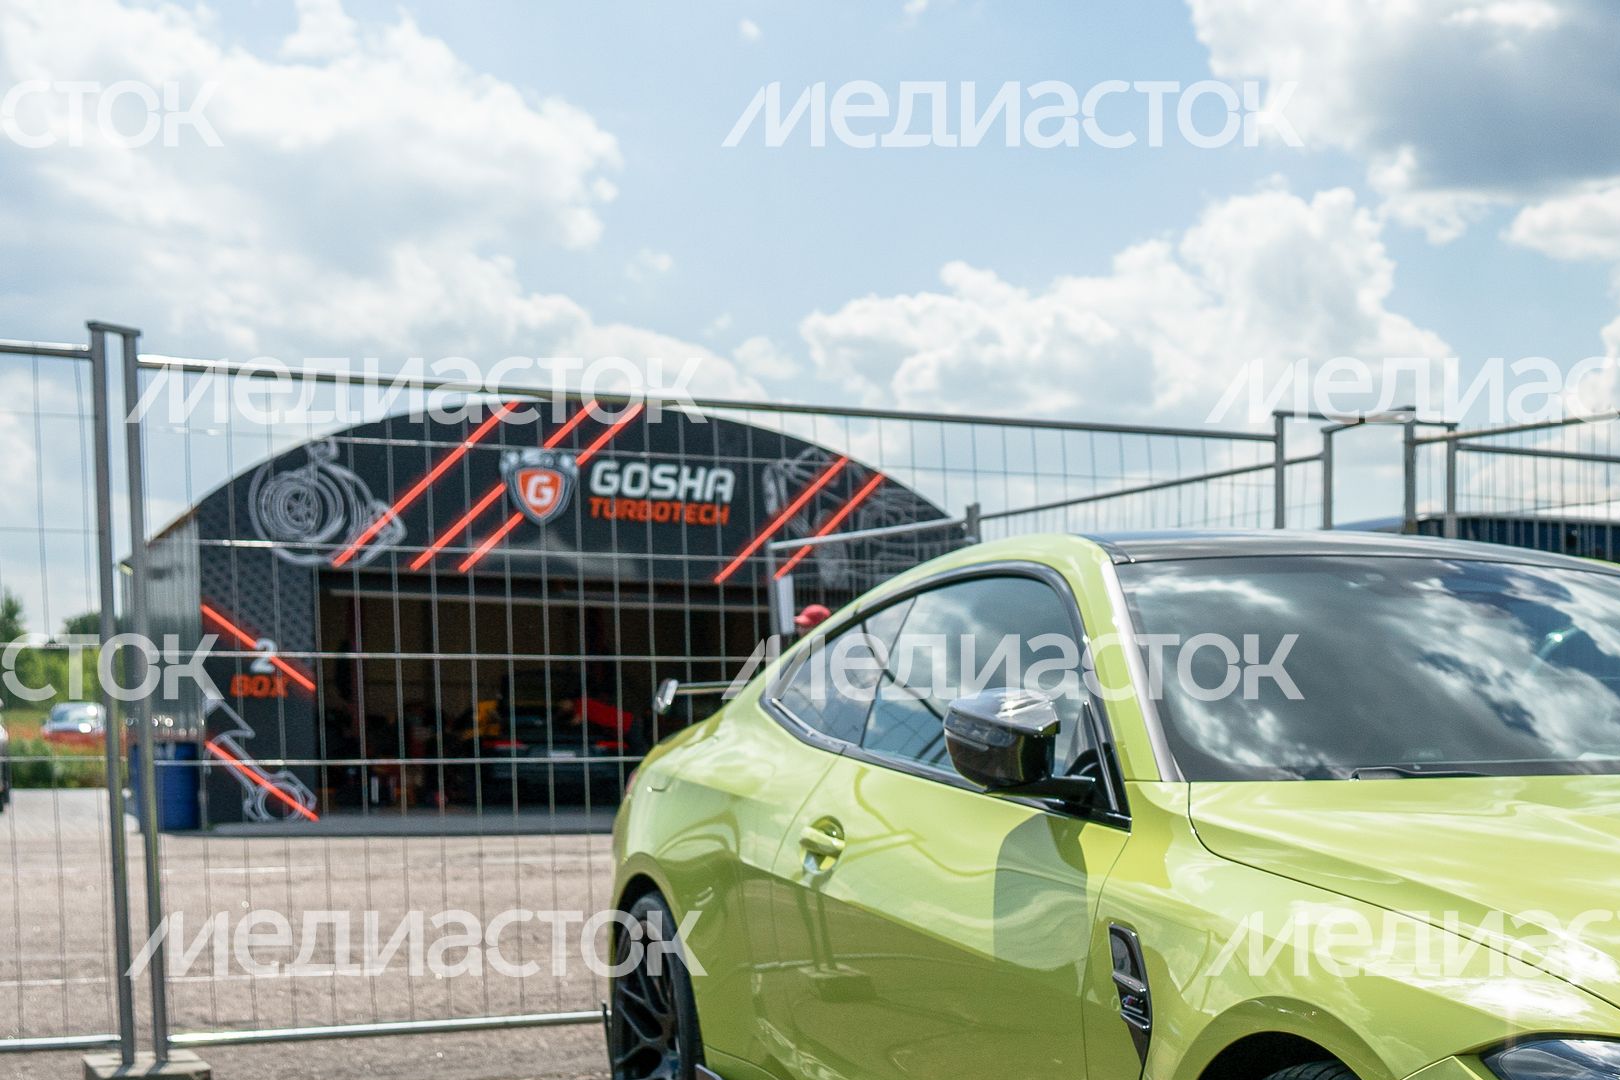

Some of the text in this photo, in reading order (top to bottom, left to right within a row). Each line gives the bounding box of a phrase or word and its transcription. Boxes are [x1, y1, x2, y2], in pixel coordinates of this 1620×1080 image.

[525, 474, 555, 506] G
[590, 460, 735, 504] GOSHA
[588, 497, 731, 526] TURBOTECH
[250, 638, 278, 673] 2
